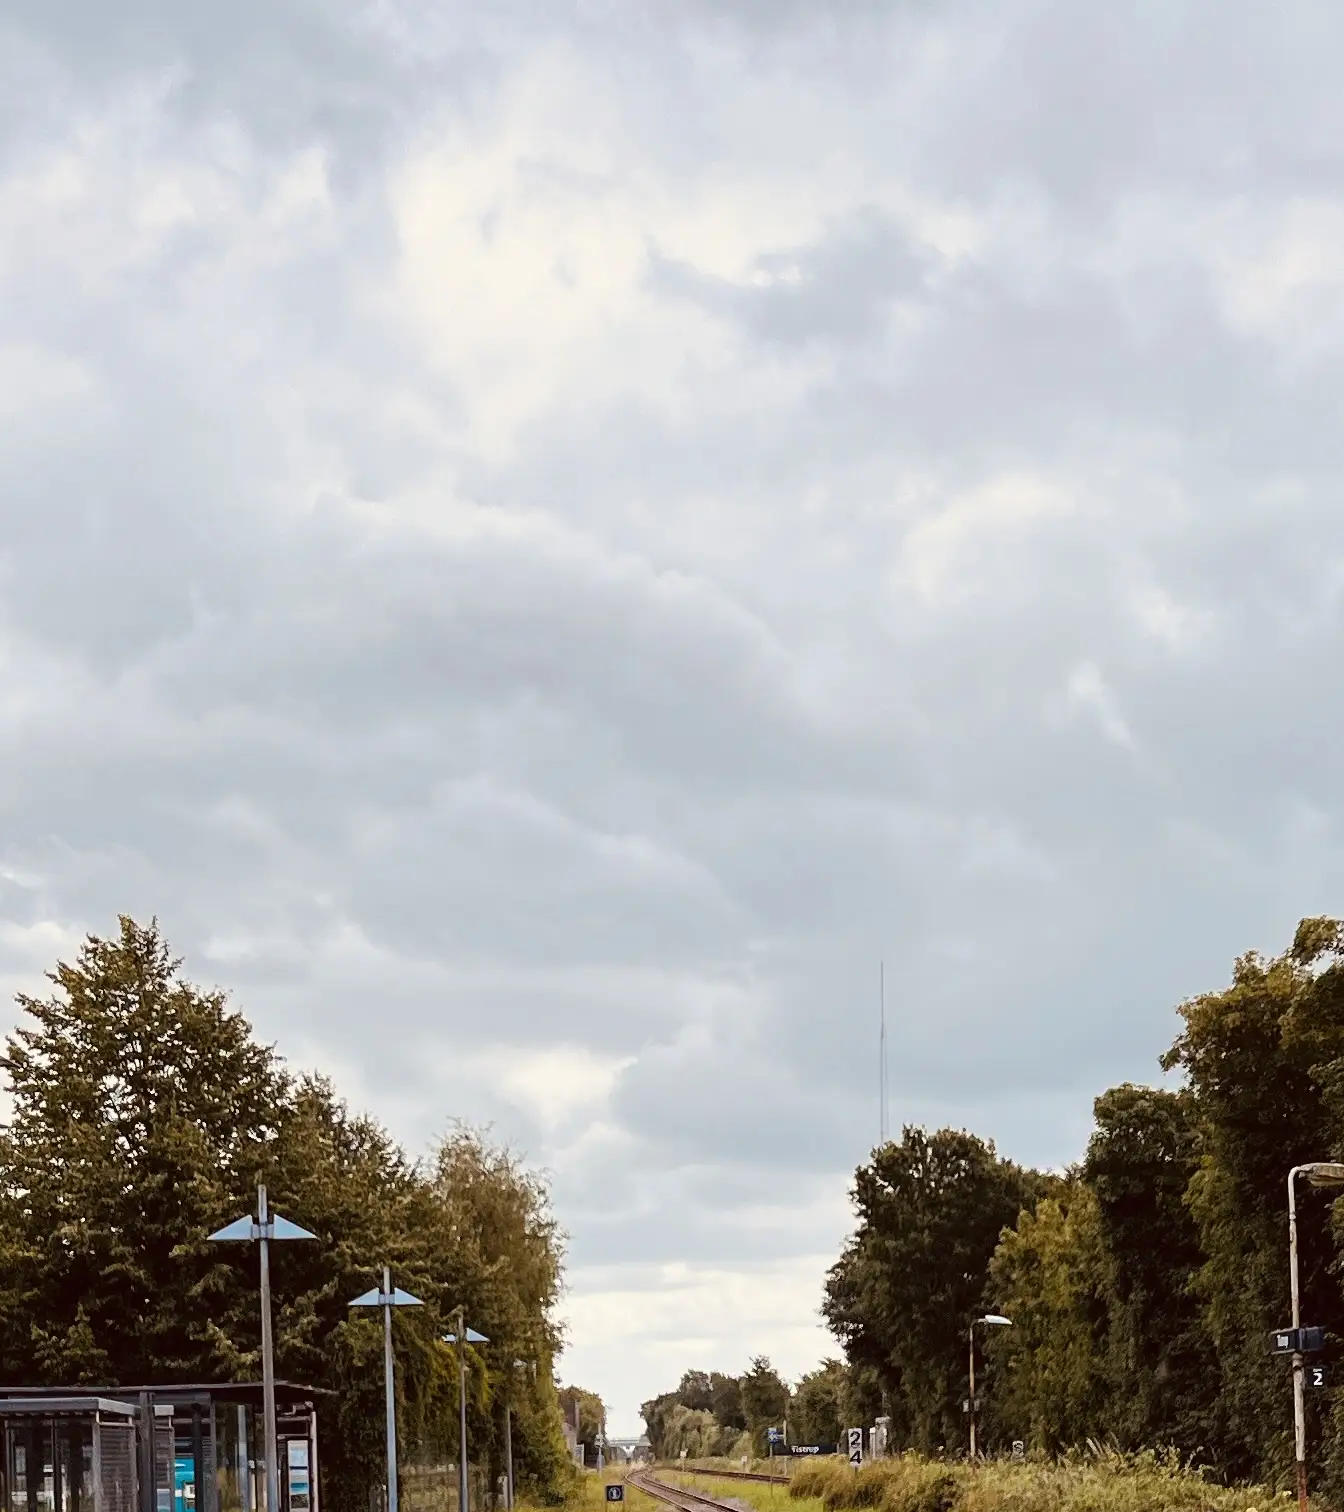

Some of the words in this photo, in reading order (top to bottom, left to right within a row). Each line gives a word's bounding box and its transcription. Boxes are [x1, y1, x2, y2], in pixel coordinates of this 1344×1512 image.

[1313, 1372, 1323, 1386] 2
[850, 1431, 861, 1447] 2
[849, 1450, 862, 1464] 4
